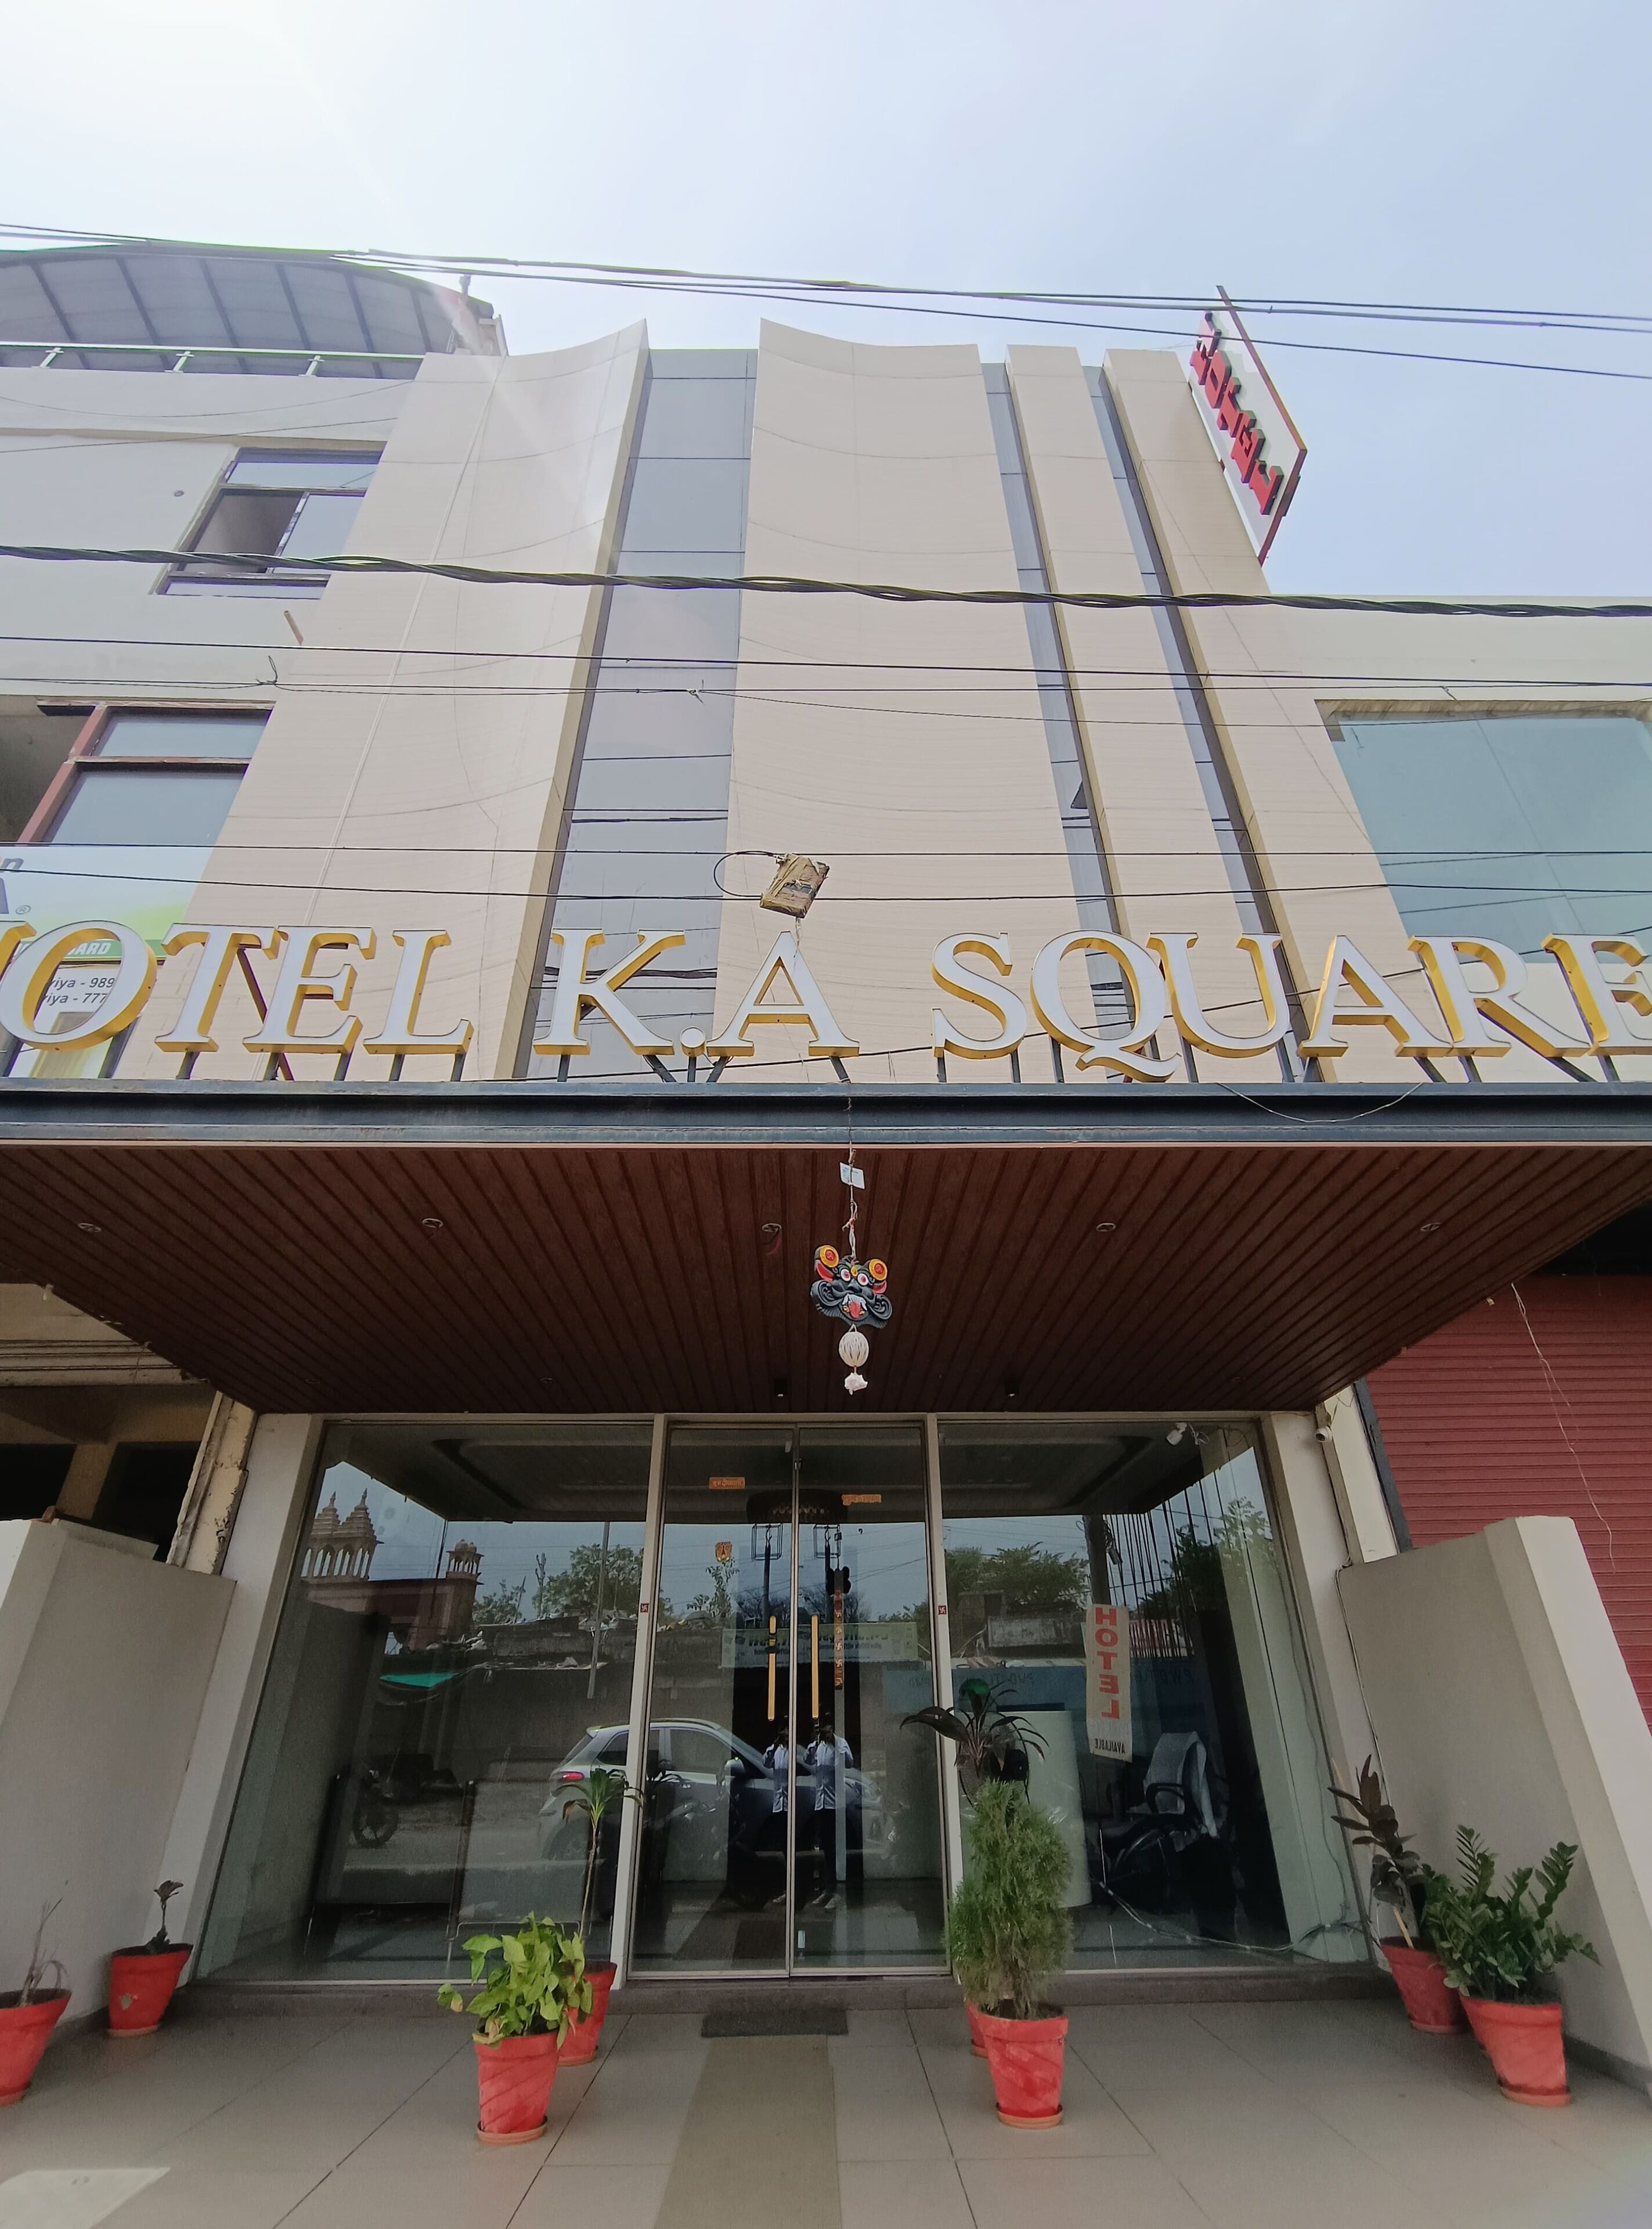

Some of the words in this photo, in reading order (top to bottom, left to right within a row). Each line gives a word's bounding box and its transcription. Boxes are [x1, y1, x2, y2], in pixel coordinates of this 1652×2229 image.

[1190, 311, 1285, 515] HOTEL
[533, 928, 860, 1057] K.A
[930, 929, 1652, 1083] SQUARE
